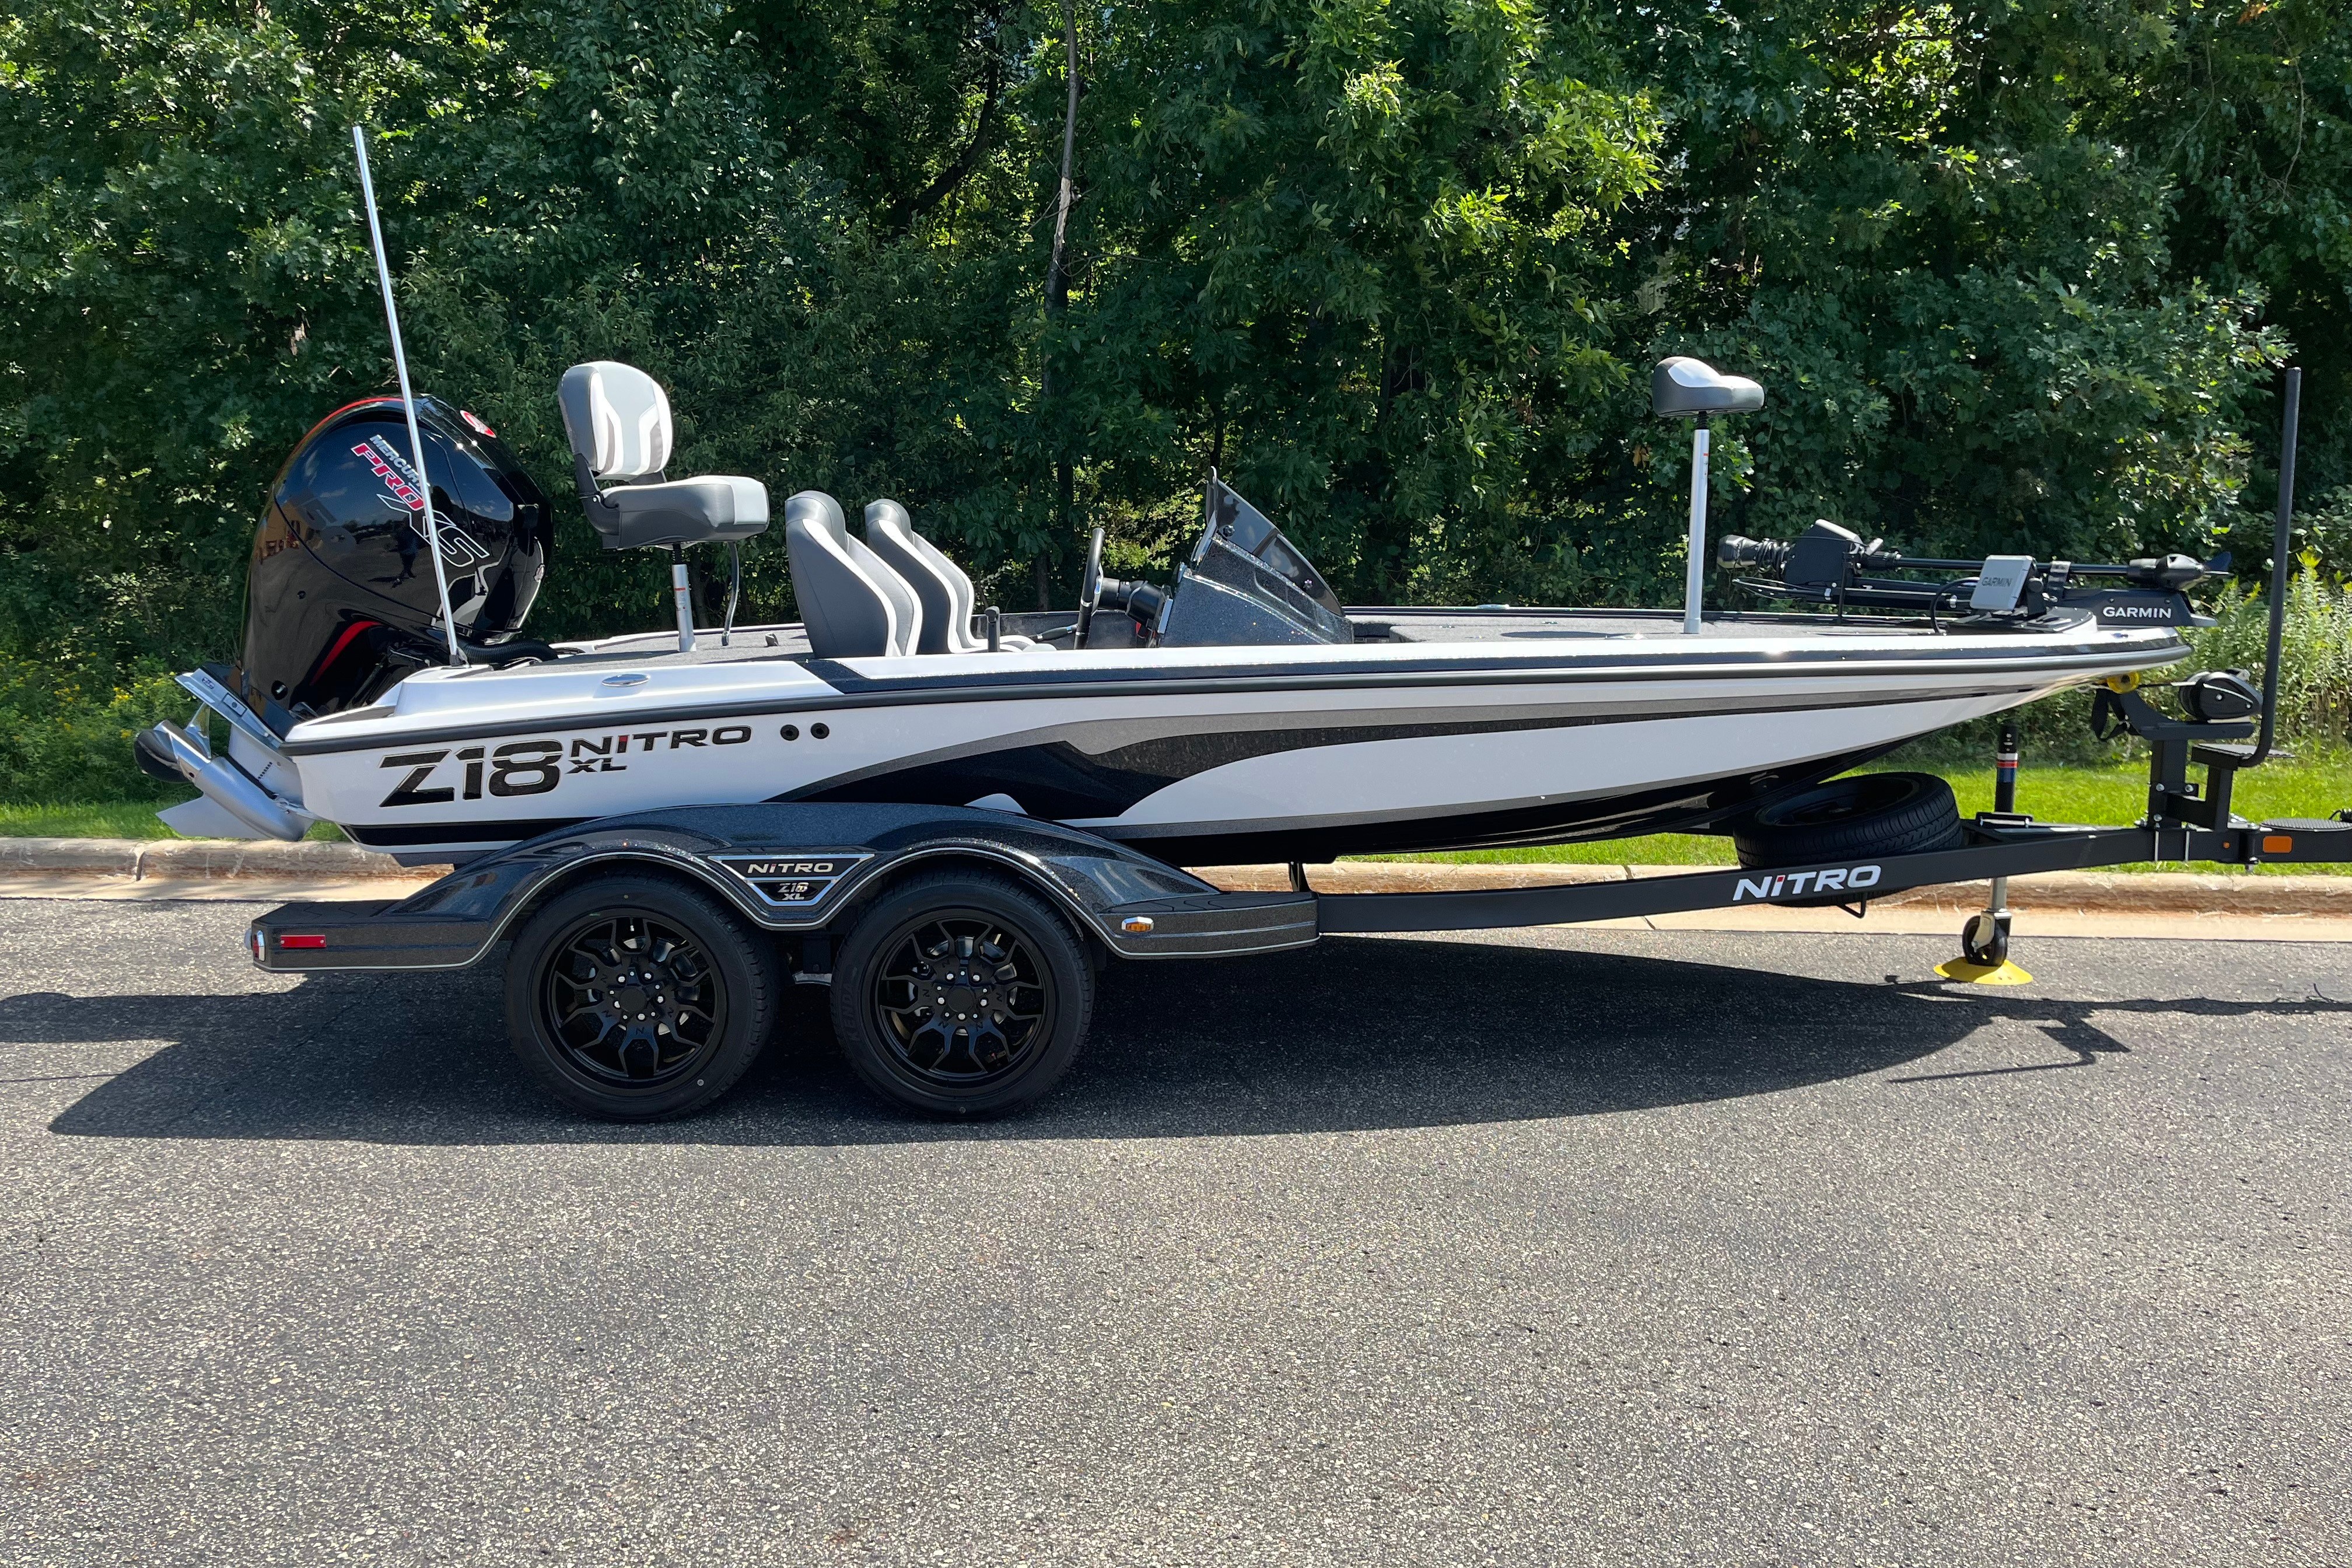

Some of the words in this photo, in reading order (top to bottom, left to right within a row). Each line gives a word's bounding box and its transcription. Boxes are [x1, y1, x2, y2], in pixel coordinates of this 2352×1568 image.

[351, 442, 426, 511] PRO
[370, 434, 431, 488] MERCUR
[376, 494, 490, 568] XS
[1982, 576, 2013, 587] GARMIN
[2102, 606, 2172, 620] GARMIN
[379, 738, 564, 807] Z18
[565, 757, 628, 775] XL
[782, 892, 805, 901] XL
